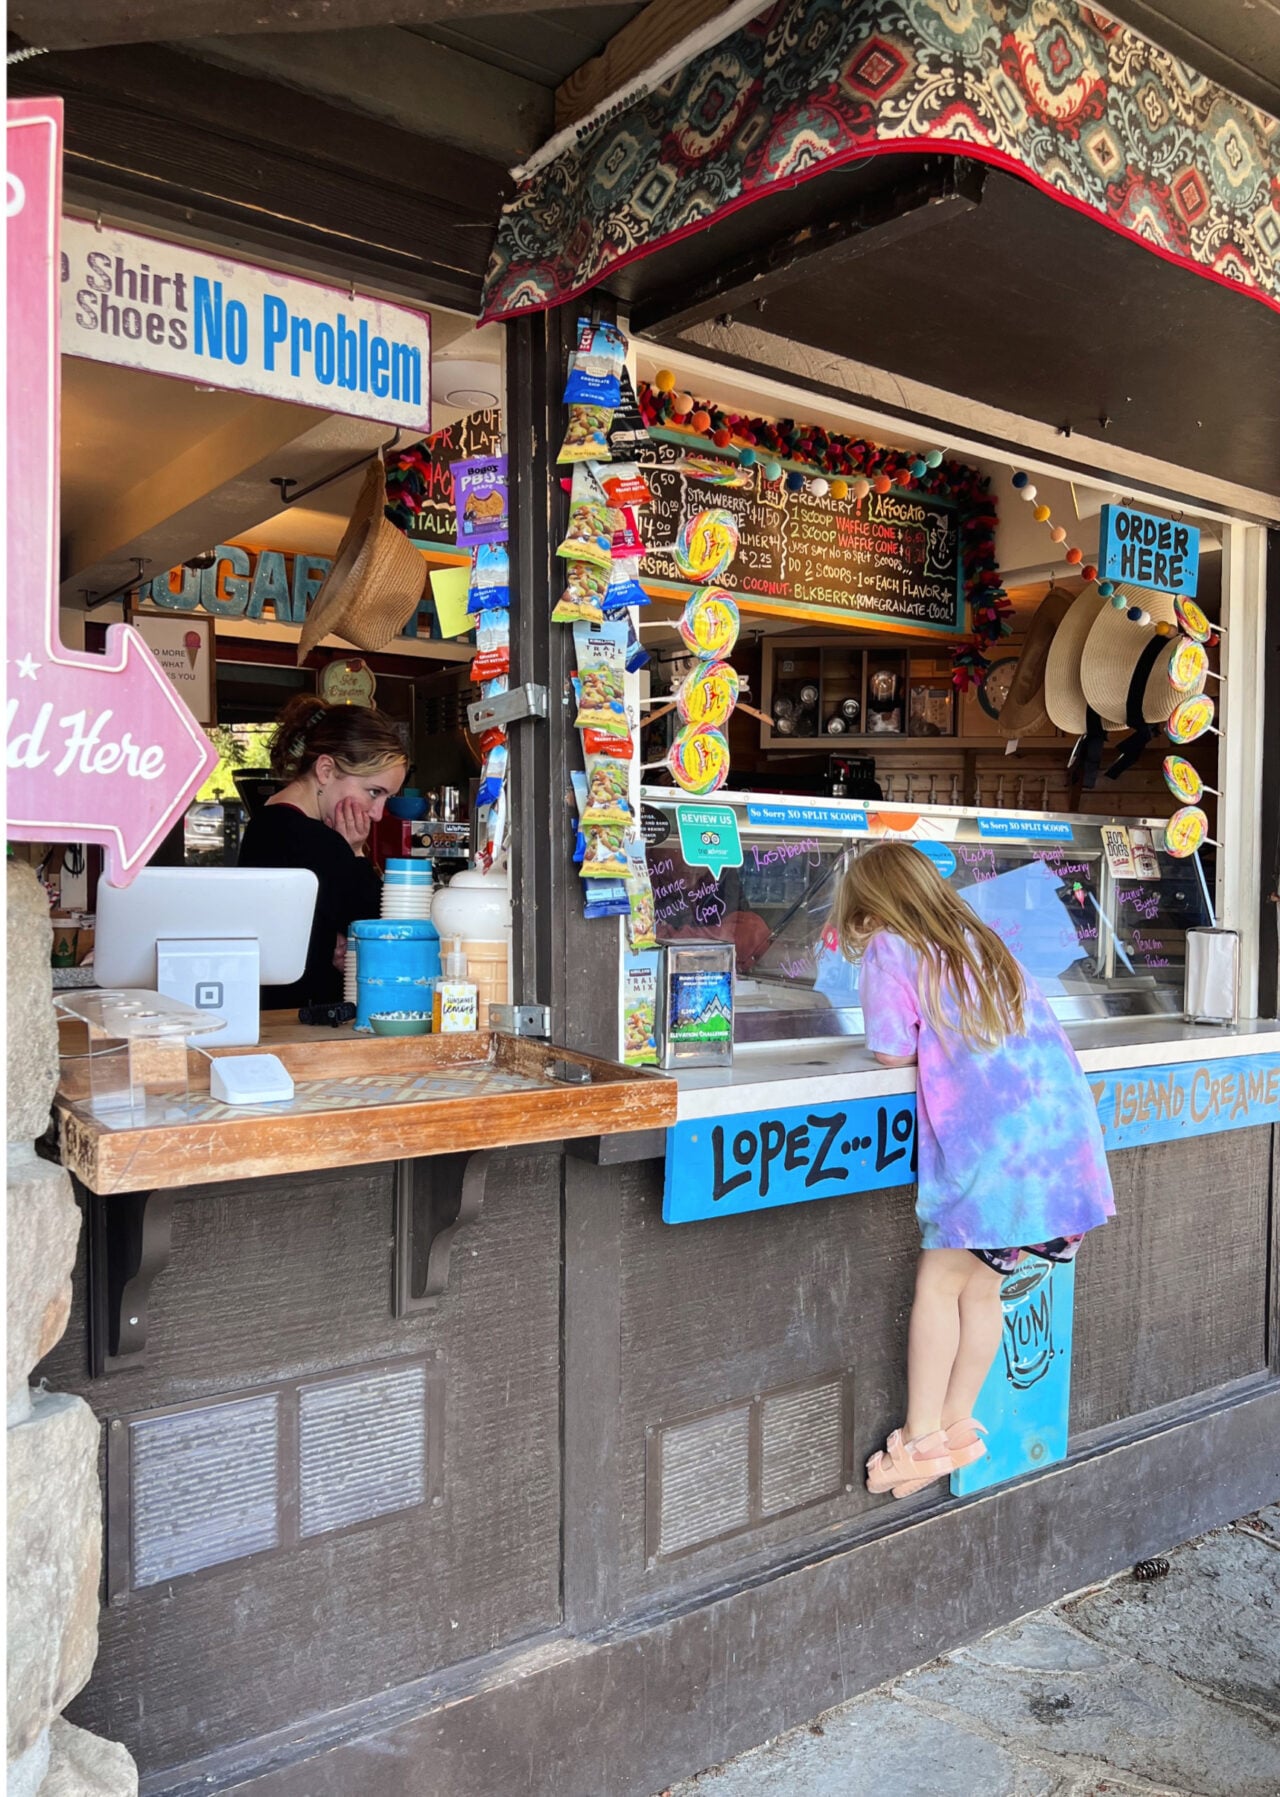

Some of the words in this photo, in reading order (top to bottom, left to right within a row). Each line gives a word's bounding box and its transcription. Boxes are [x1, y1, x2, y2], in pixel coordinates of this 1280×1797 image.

[86, 252, 188, 313] Shirt
[76, 289, 188, 350] Shoes
[193, 275, 248, 366] No
[264, 293, 420, 405] Problem
[687, 488, 752, 515] STRAWBERRY
[790, 522, 800, 538] 2
[802, 524, 836, 543] SCOOP
[838, 534, 874, 551] WAFFLE
[875, 540, 898, 556] CONE
[801, 509, 833, 527] SCOOP
[836, 516, 869, 536] WAFFLE
[872, 525, 895, 540] CONE
[1115, 511, 1188, 557] ORDER
[789, 541, 809, 556] JUST
[811, 545, 827, 560] SAY
[788, 557, 800, 572] DO
[876, 575, 899, 594] EACH
[903, 580, 941, 600] FLAVOR
[162, 649, 185, 657] MORE
[178, 673, 196, 681] YOU
[53, 709, 166, 780] Here
[681, 813, 717, 824] REVIEW
[720, 814, 732, 825] US
[750, 808, 761, 817] So
[763, 808, 785, 820] Sorry
[787, 810, 800, 819] NO
[802, 810, 828, 820] SPLIT
[830, 812, 864, 822] SCOOPS
[980, 821, 989, 829] So
[990, 822, 1008, 831] Sorry
[1009, 822, 1020, 830] NO
[1021, 823, 1041, 831] SPLIT
[1042, 823, 1069, 832] SCOOPS
[1106, 832, 1123, 845] HOT
[1108, 844, 1129, 857] DOGS
[751, 838, 821, 872] Raspberry
[633, 984, 653, 992] MIX
[1113, 1072, 1184, 1129] ISLAND
